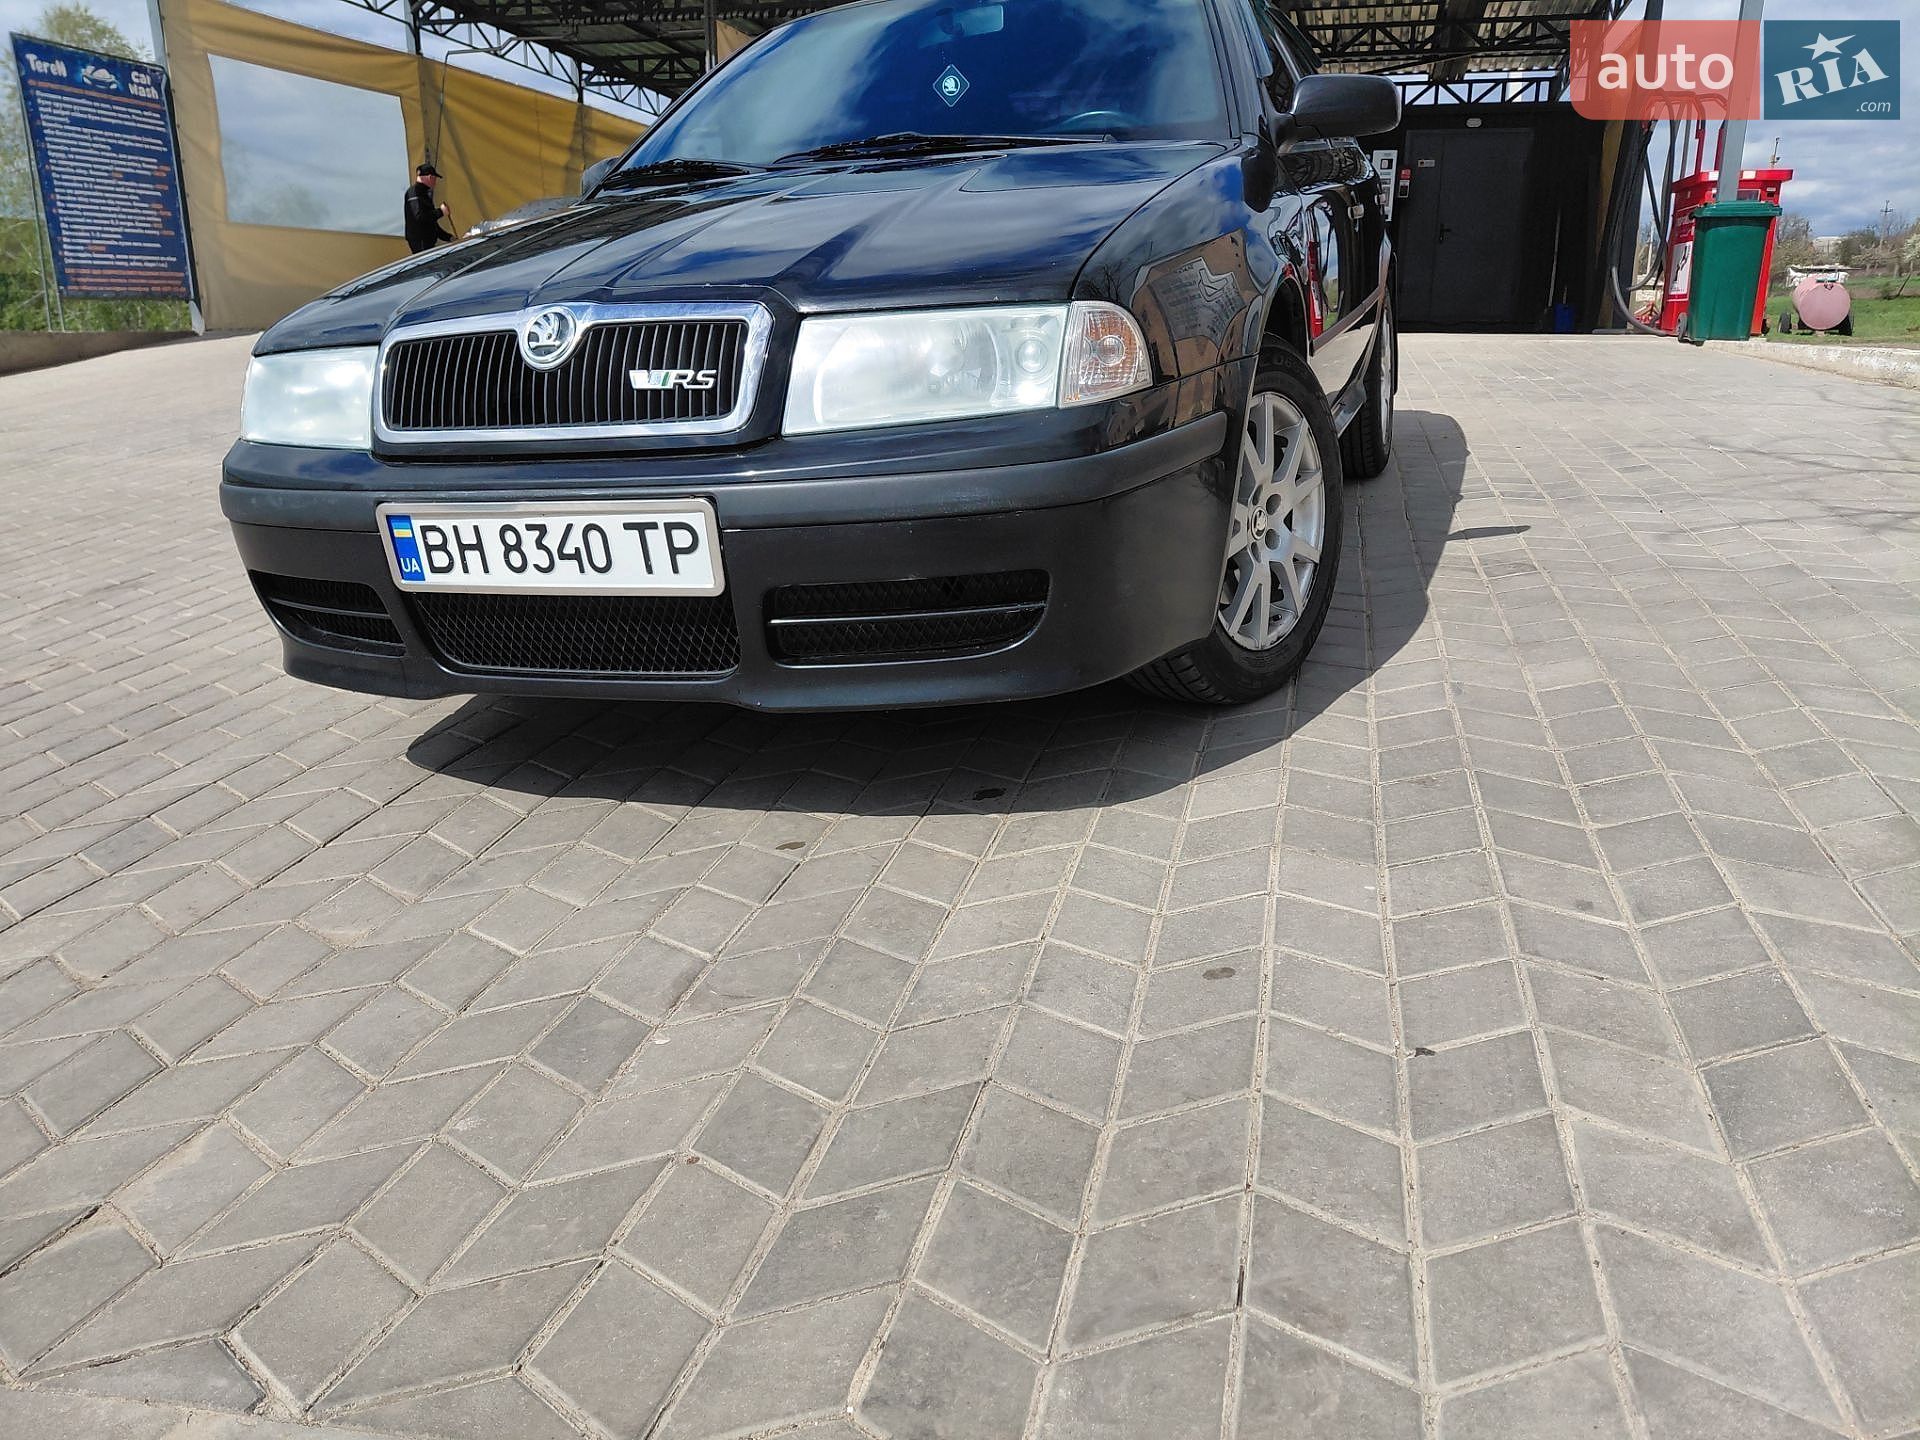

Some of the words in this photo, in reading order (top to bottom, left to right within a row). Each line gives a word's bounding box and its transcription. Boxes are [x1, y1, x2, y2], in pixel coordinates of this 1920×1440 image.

[130, 70, 152, 86] Car
[127, 83, 160, 100] Wash
[419, 525, 490, 574] BH
[498, 523, 613, 575] 8340
[622, 521, 700, 575] TP
[400, 557, 422, 573] UA
